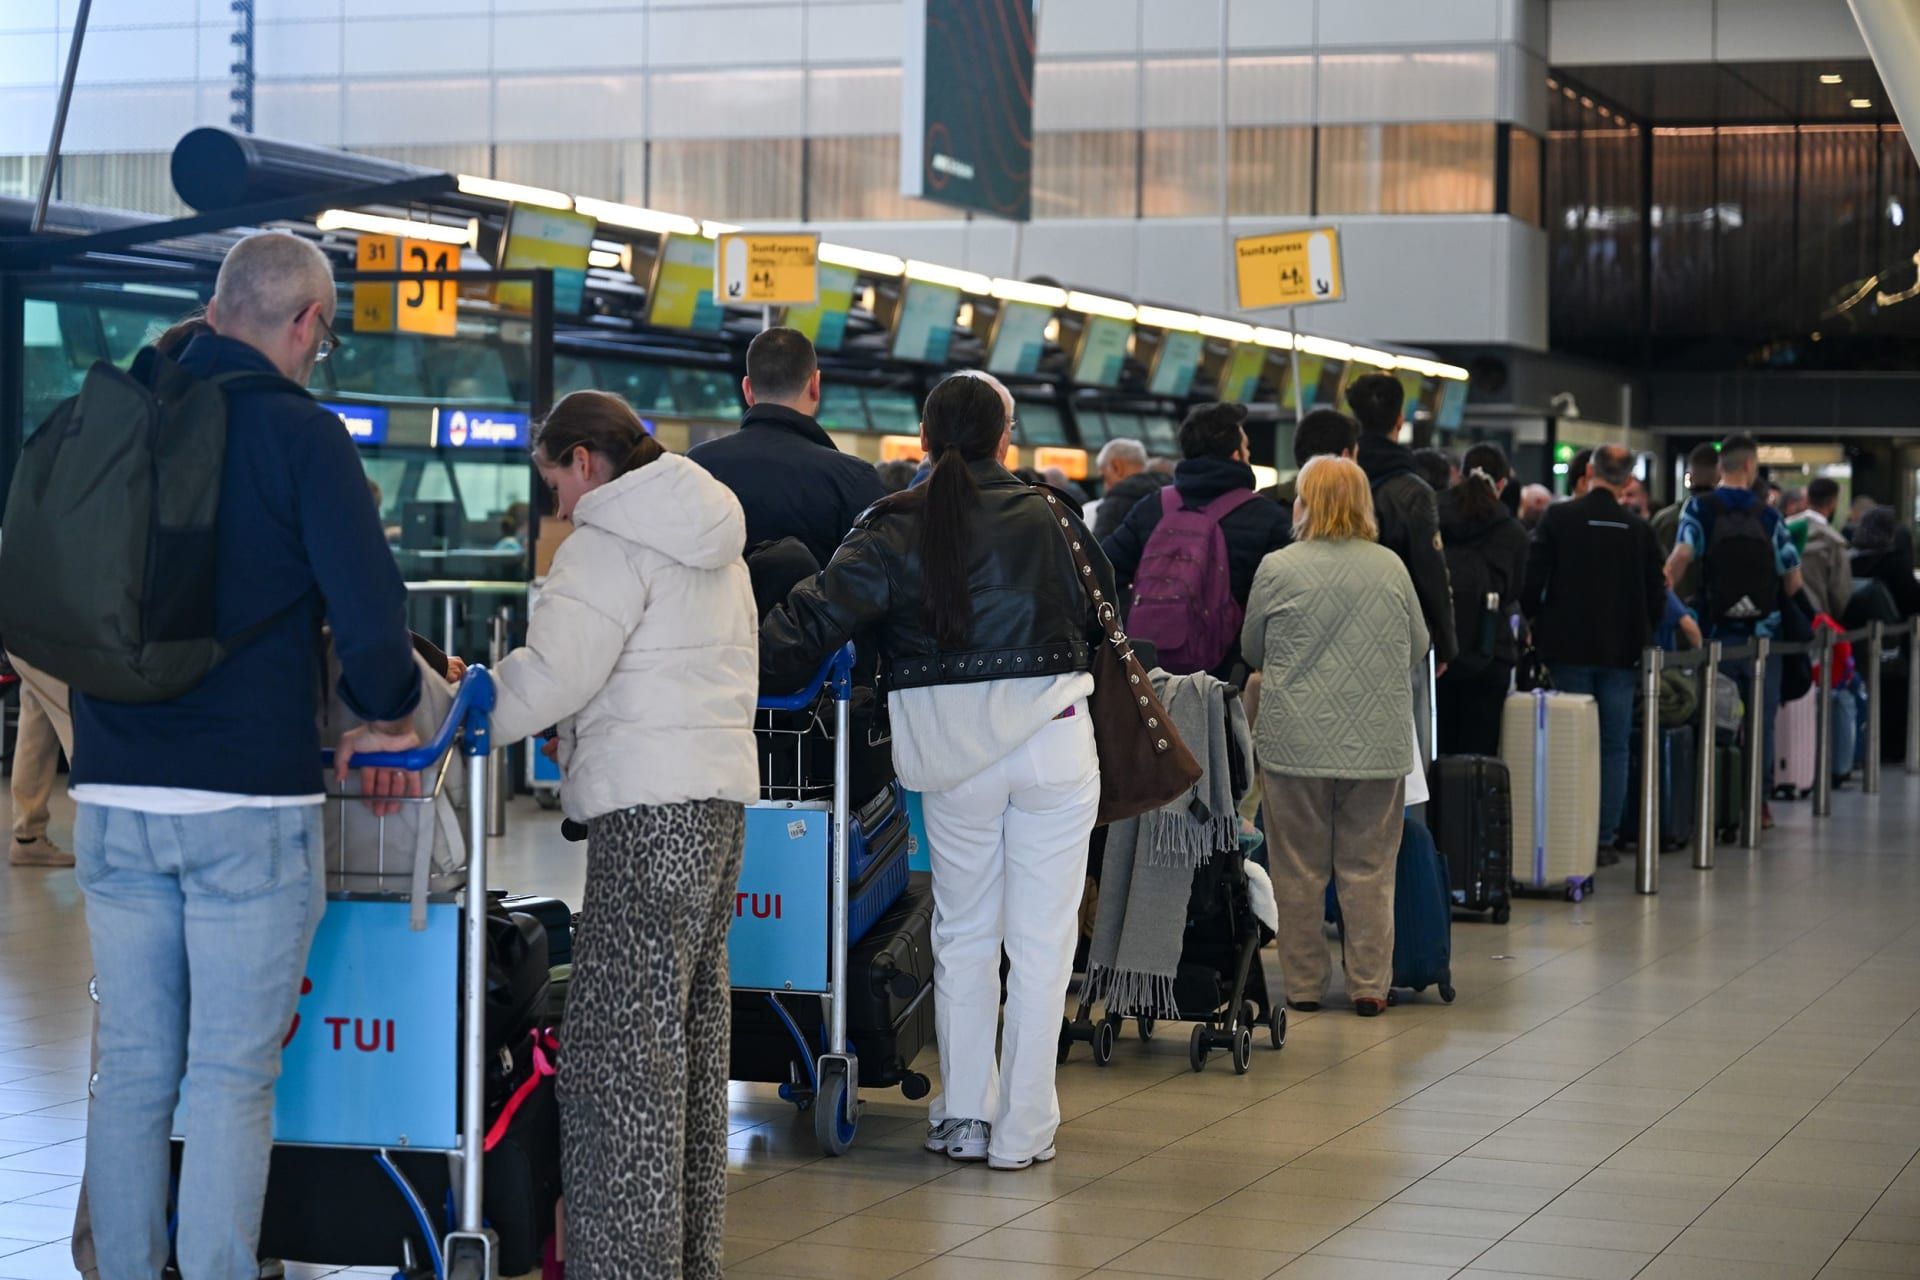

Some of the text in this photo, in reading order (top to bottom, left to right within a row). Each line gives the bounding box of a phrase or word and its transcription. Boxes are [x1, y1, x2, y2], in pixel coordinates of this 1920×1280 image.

[368, 243, 386, 261] 31
[751, 243, 810, 254] SunExpress
[1239, 242, 1303, 257] SunExpress
[406, 246, 448, 310] 31
[735, 892, 782, 919] TUI
[323, 1016, 395, 1053] TUI
